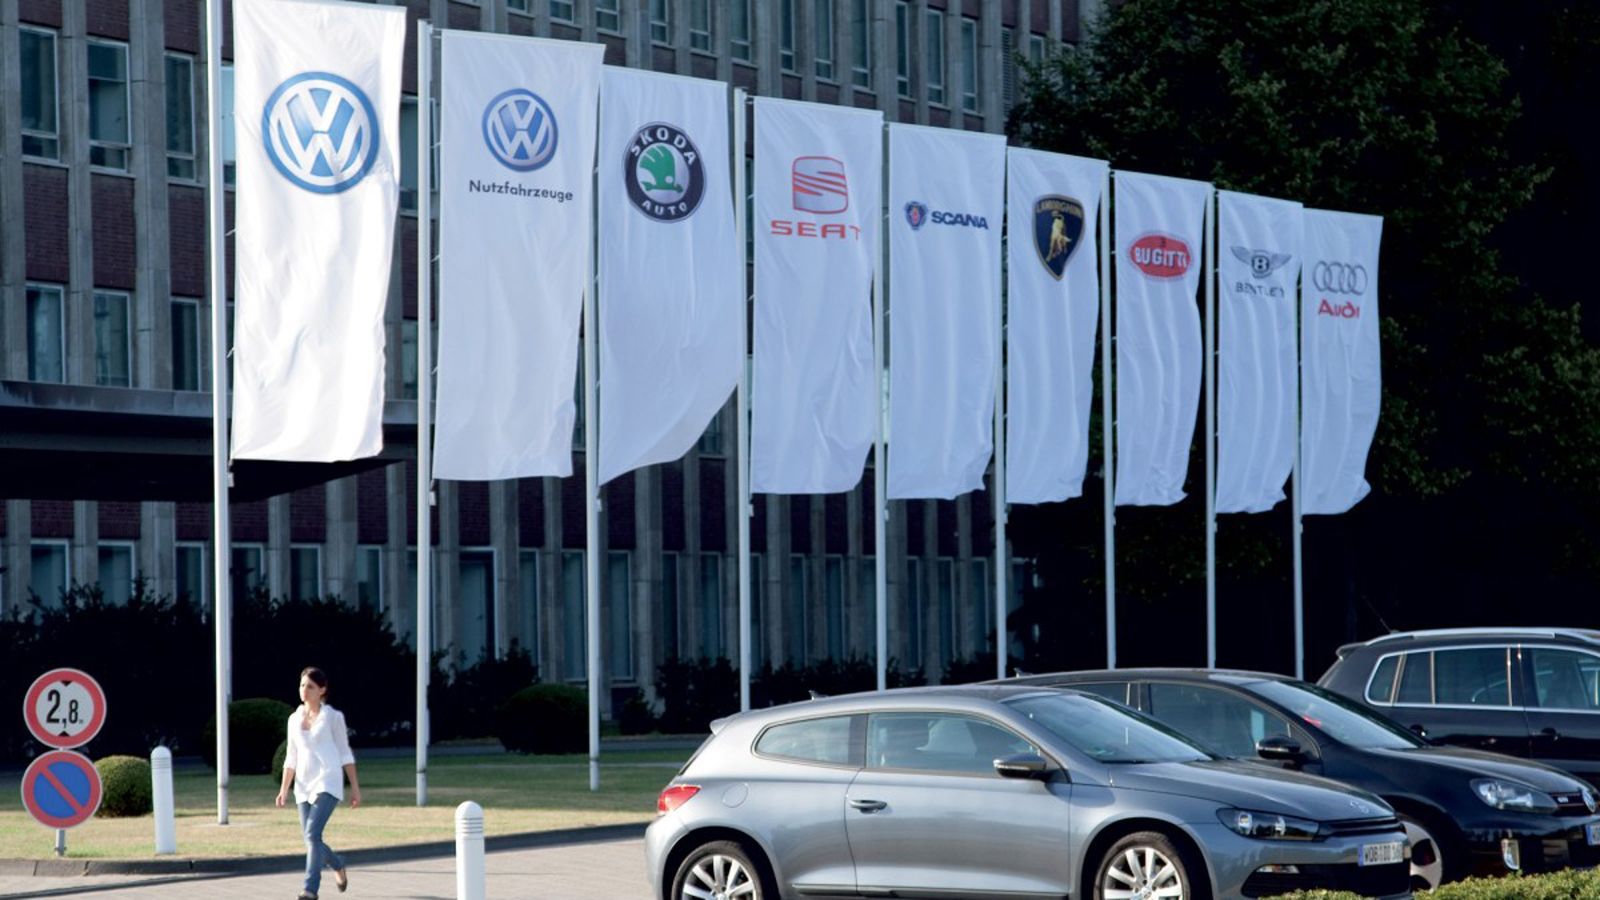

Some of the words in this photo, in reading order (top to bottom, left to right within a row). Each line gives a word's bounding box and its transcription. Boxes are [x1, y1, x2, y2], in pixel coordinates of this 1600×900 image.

[469, 180, 574, 203] Nutzfahrzeuge
[642, 200, 688, 215] AUTO
[770, 220, 861, 240] SEAT
[1318, 299, 1360, 318] Audi
[46, 689, 79, 729] 2,8
